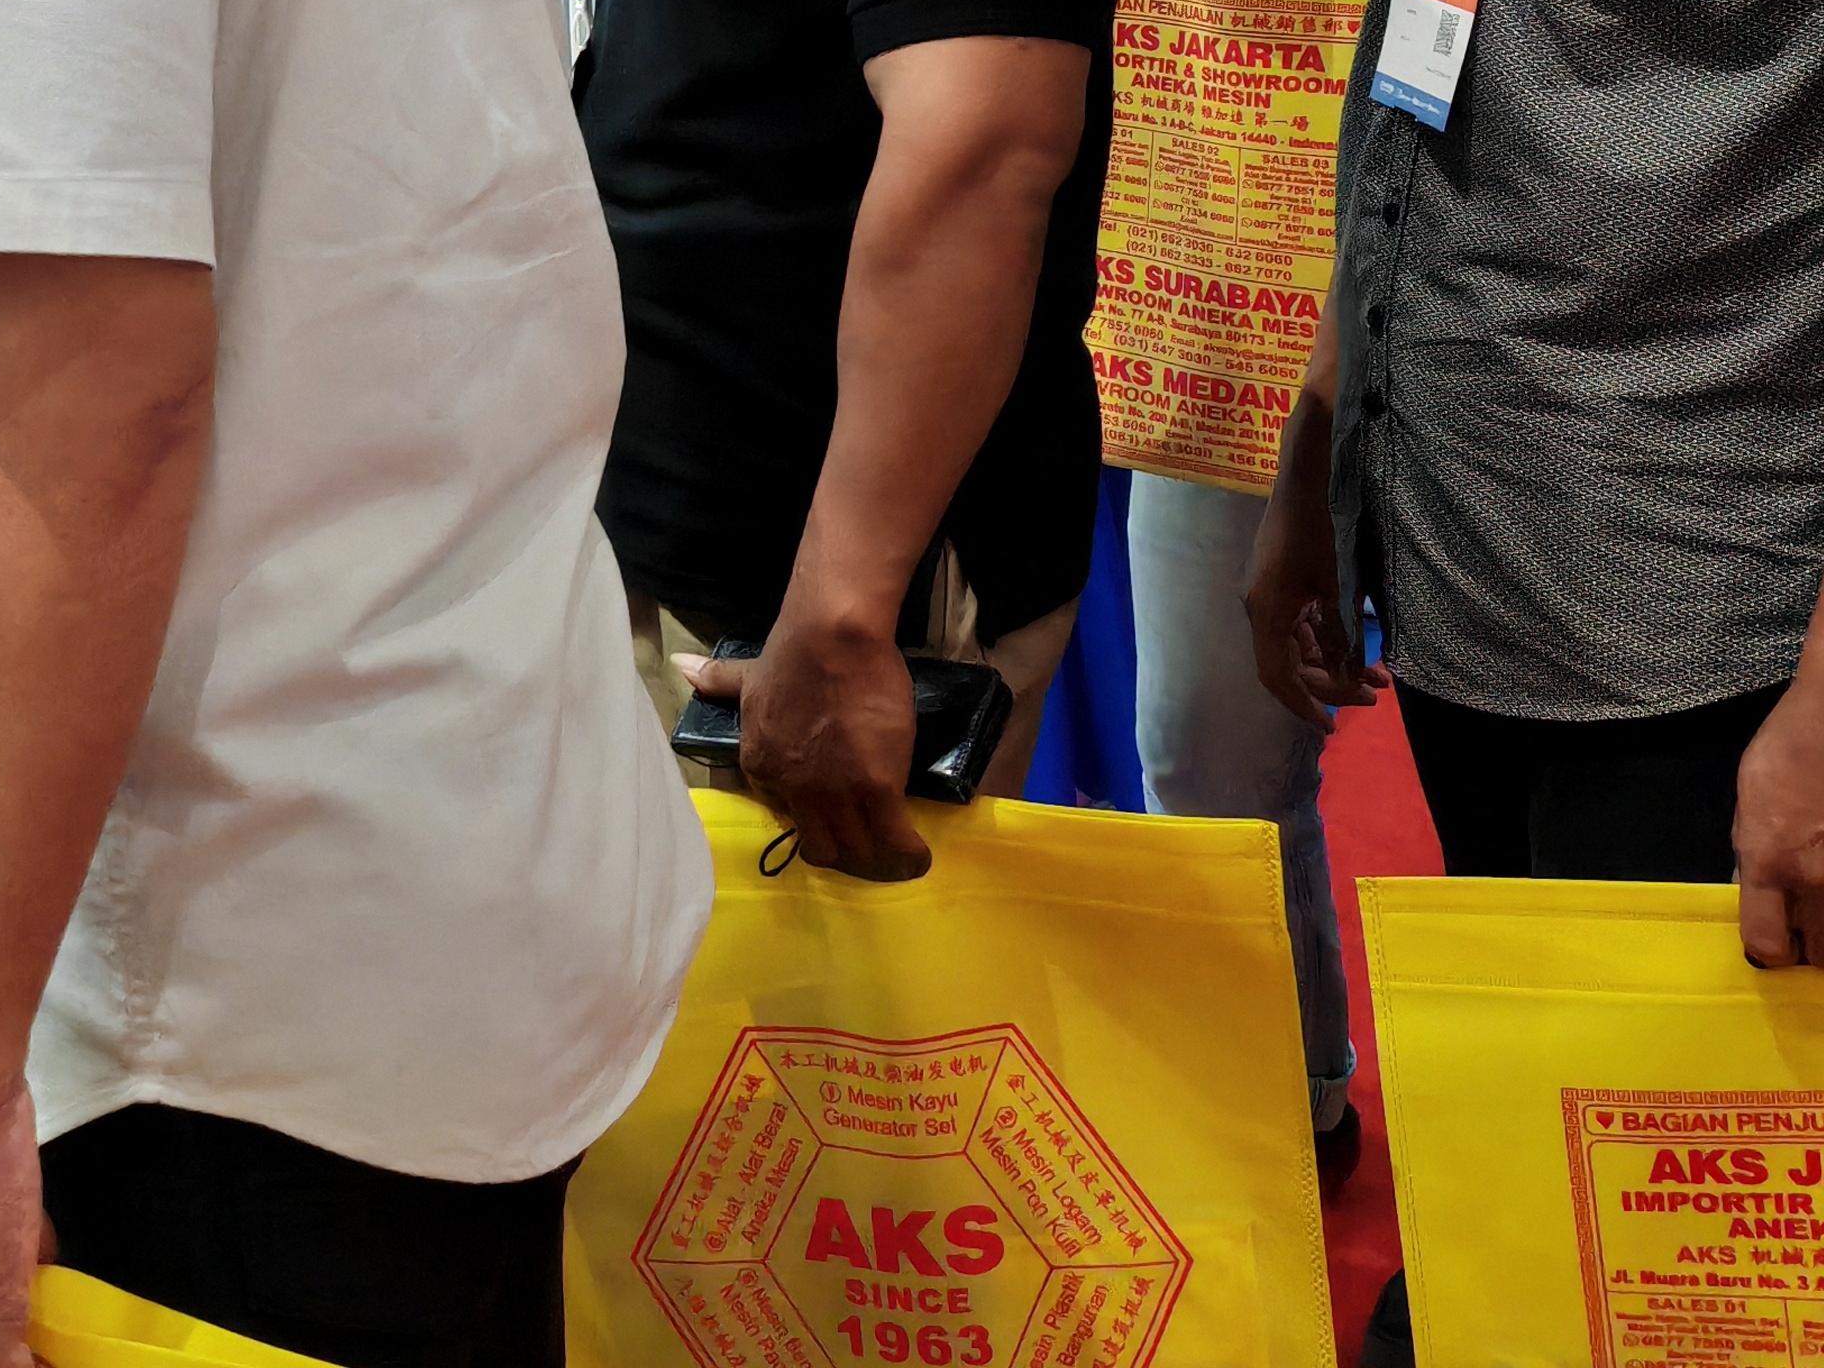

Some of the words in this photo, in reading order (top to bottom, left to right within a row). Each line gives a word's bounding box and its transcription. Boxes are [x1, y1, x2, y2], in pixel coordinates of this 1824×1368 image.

[1149, 1, 1223, 25] PENJUALAN
[1115, 23, 1160, 50] KS
[1169, 31, 1326, 72] JAKARTA
[1115, 53, 1178, 75] ORTIR
[1184, 63, 1195, 78] &
[1201, 67, 1347, 96] SHOWROOM
[1113, 91, 1133, 105] KS
[1131, 73, 1198, 98] ANEKA
[1203, 86, 1272, 109] MESIN
[1172, 137, 1205, 153] SALES
[1262, 154, 1308, 167] SALES
[1097, 255, 1135, 284] KS
[1144, 265, 1320, 321] SURABAYA
[1178, 303, 1254, 331] ANEKA
[1093, 351, 1153, 386] AKS
[1163, 367, 1291, 413] MEDAN
[1177, 399, 1255, 427] ANEKA
[847, 1085, 903, 1111] Mesin
[909, 1091, 958, 1113] Kayu
[824, 1108, 918, 1137] Generator
[1622, 1112, 1728, 1132] BAGIAN
[1737, 1113, 1824, 1132] PENJU
[980, 1127, 1021, 1182] Mesin
[1648, 1149, 1769, 1185] AKS
[1013, 1128, 1056, 1182] Mesin
[1052, 1181, 1102, 1246] Logam
[1622, 1191, 1815, 1215] IMPORTIR
[805, 1197, 1005, 1278] AKS
[1677, 1245, 1737, 1265] AKS
[845, 1278, 975, 1315] SINCE
[1648, 1298, 1719, 1312] SALES
[837, 1314, 993, 1367] 1963
